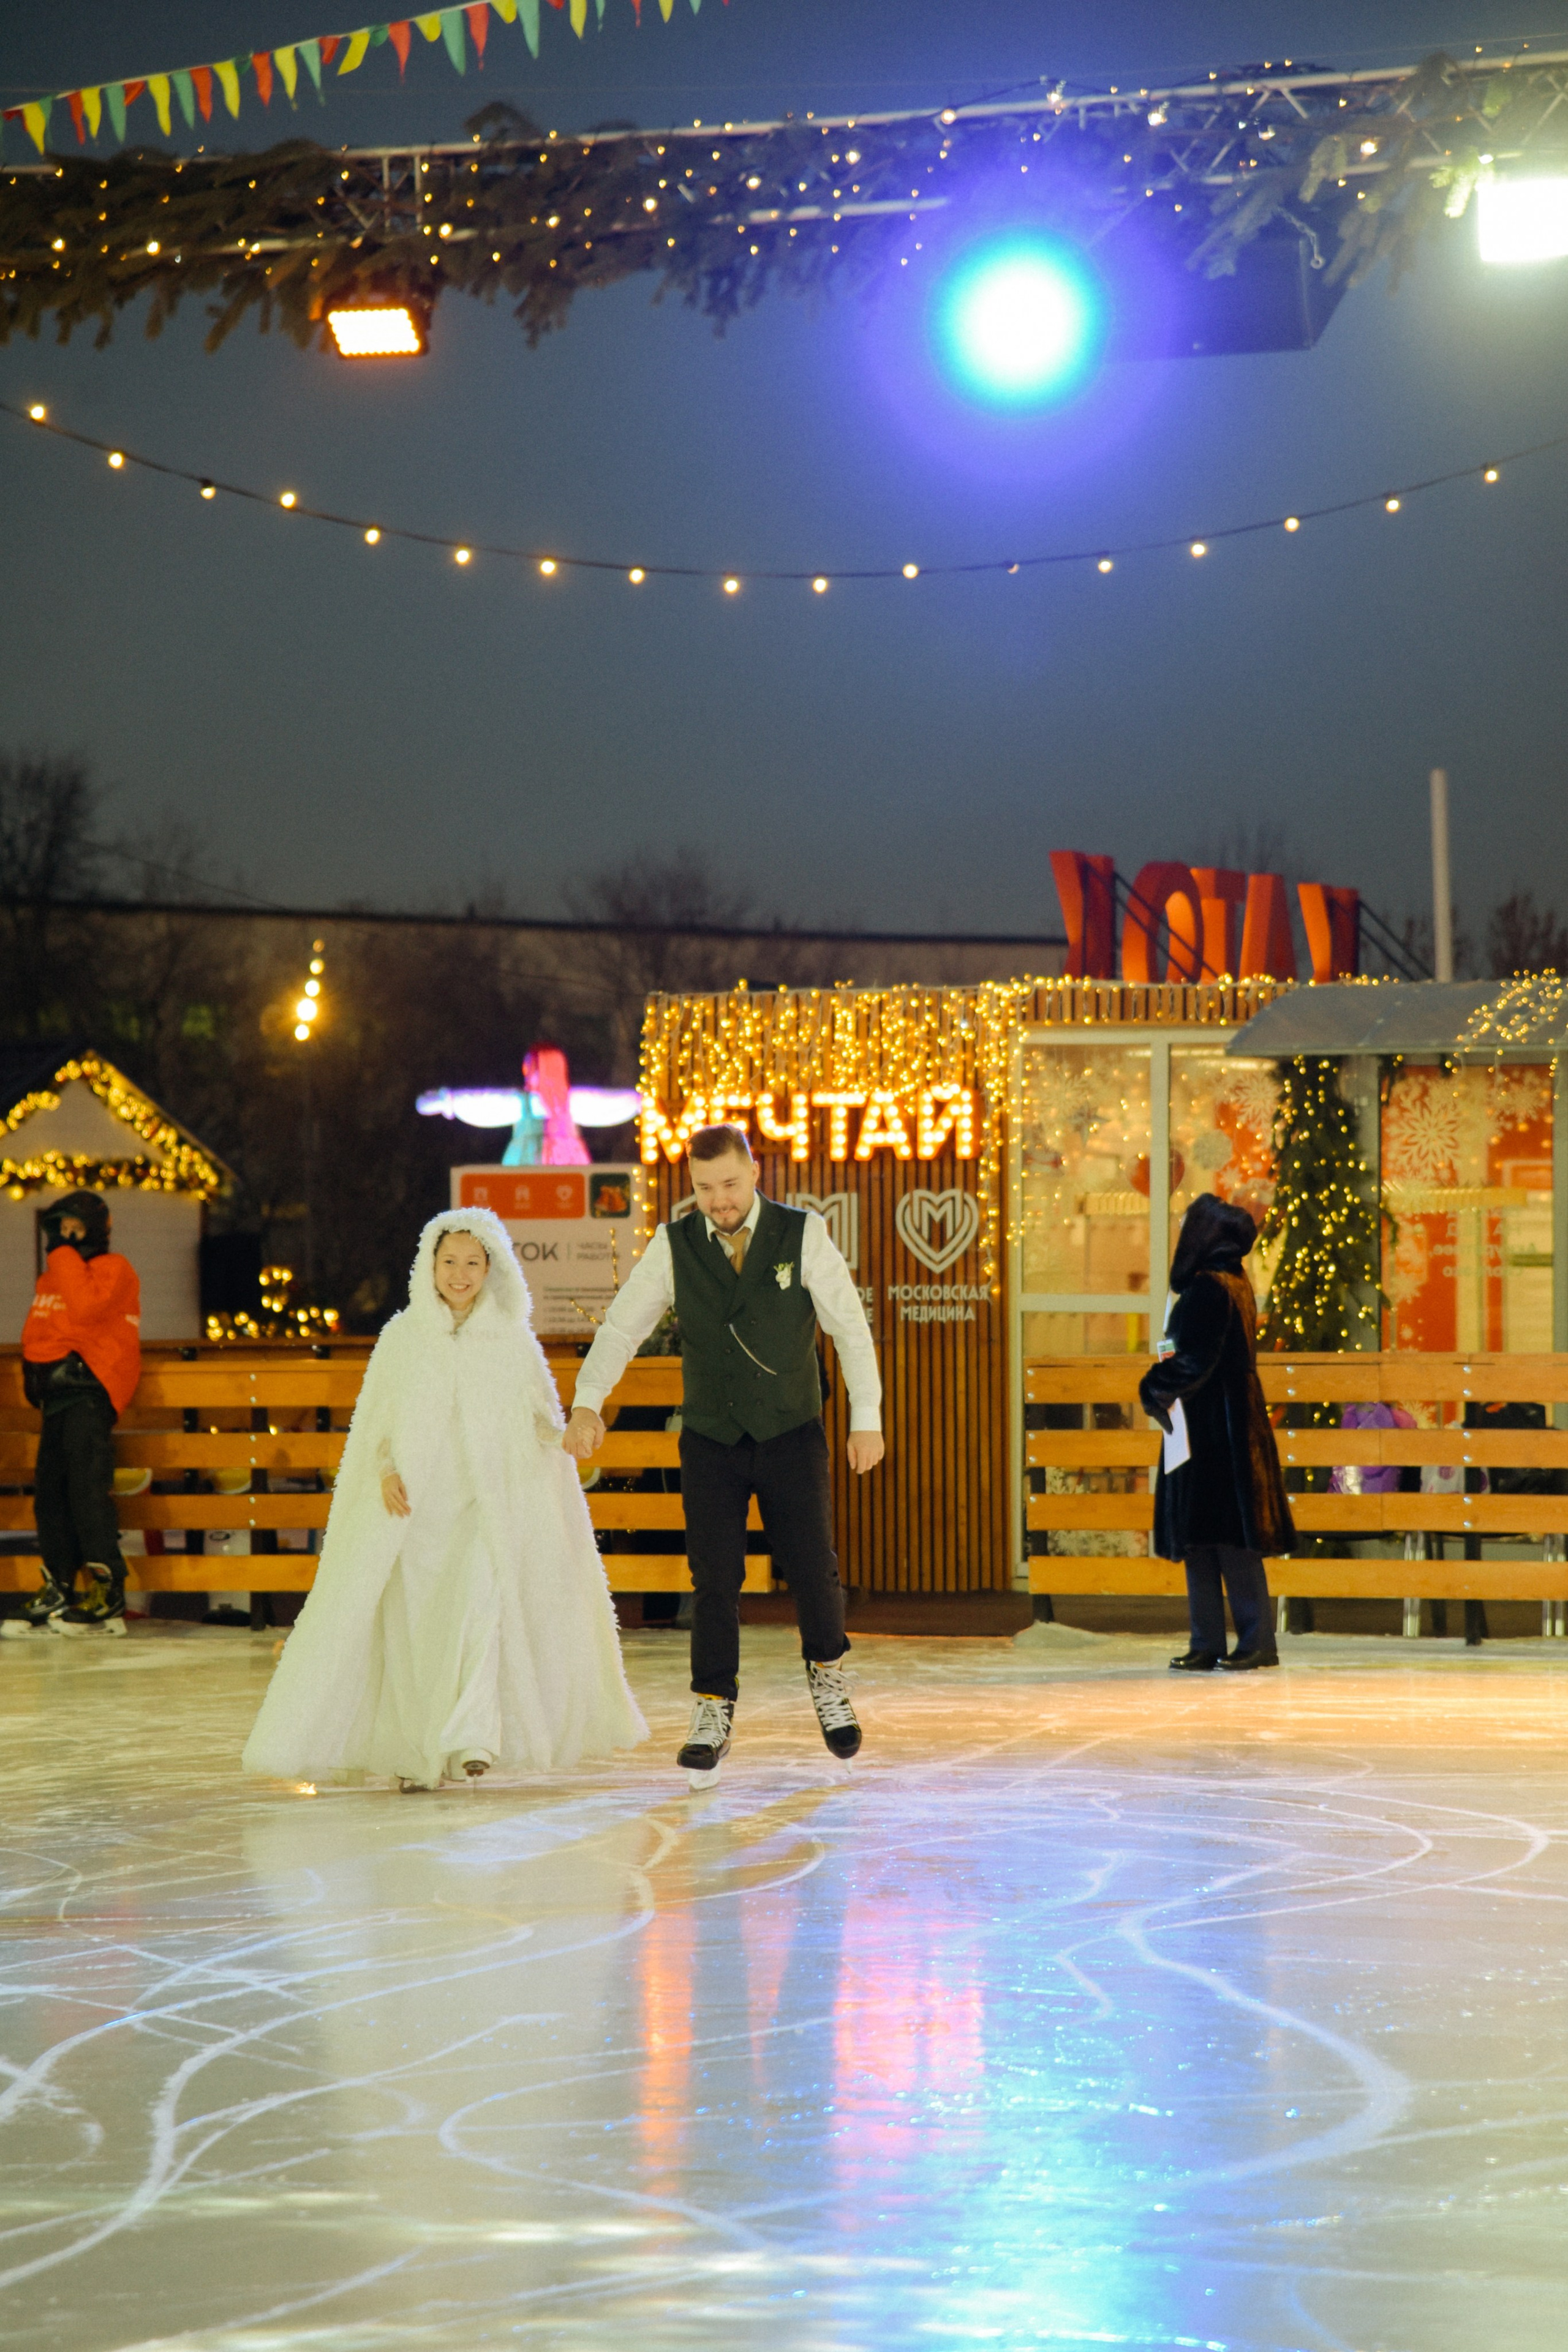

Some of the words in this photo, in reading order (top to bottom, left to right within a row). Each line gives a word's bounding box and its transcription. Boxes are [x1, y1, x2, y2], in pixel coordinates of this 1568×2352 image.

[641, 1082, 974, 1165] МЕЧТАЙ
[888, 1284, 989, 1301] МОСКОВСКАЯ
[900, 1305, 976, 1324] МЕДИЦИНА
